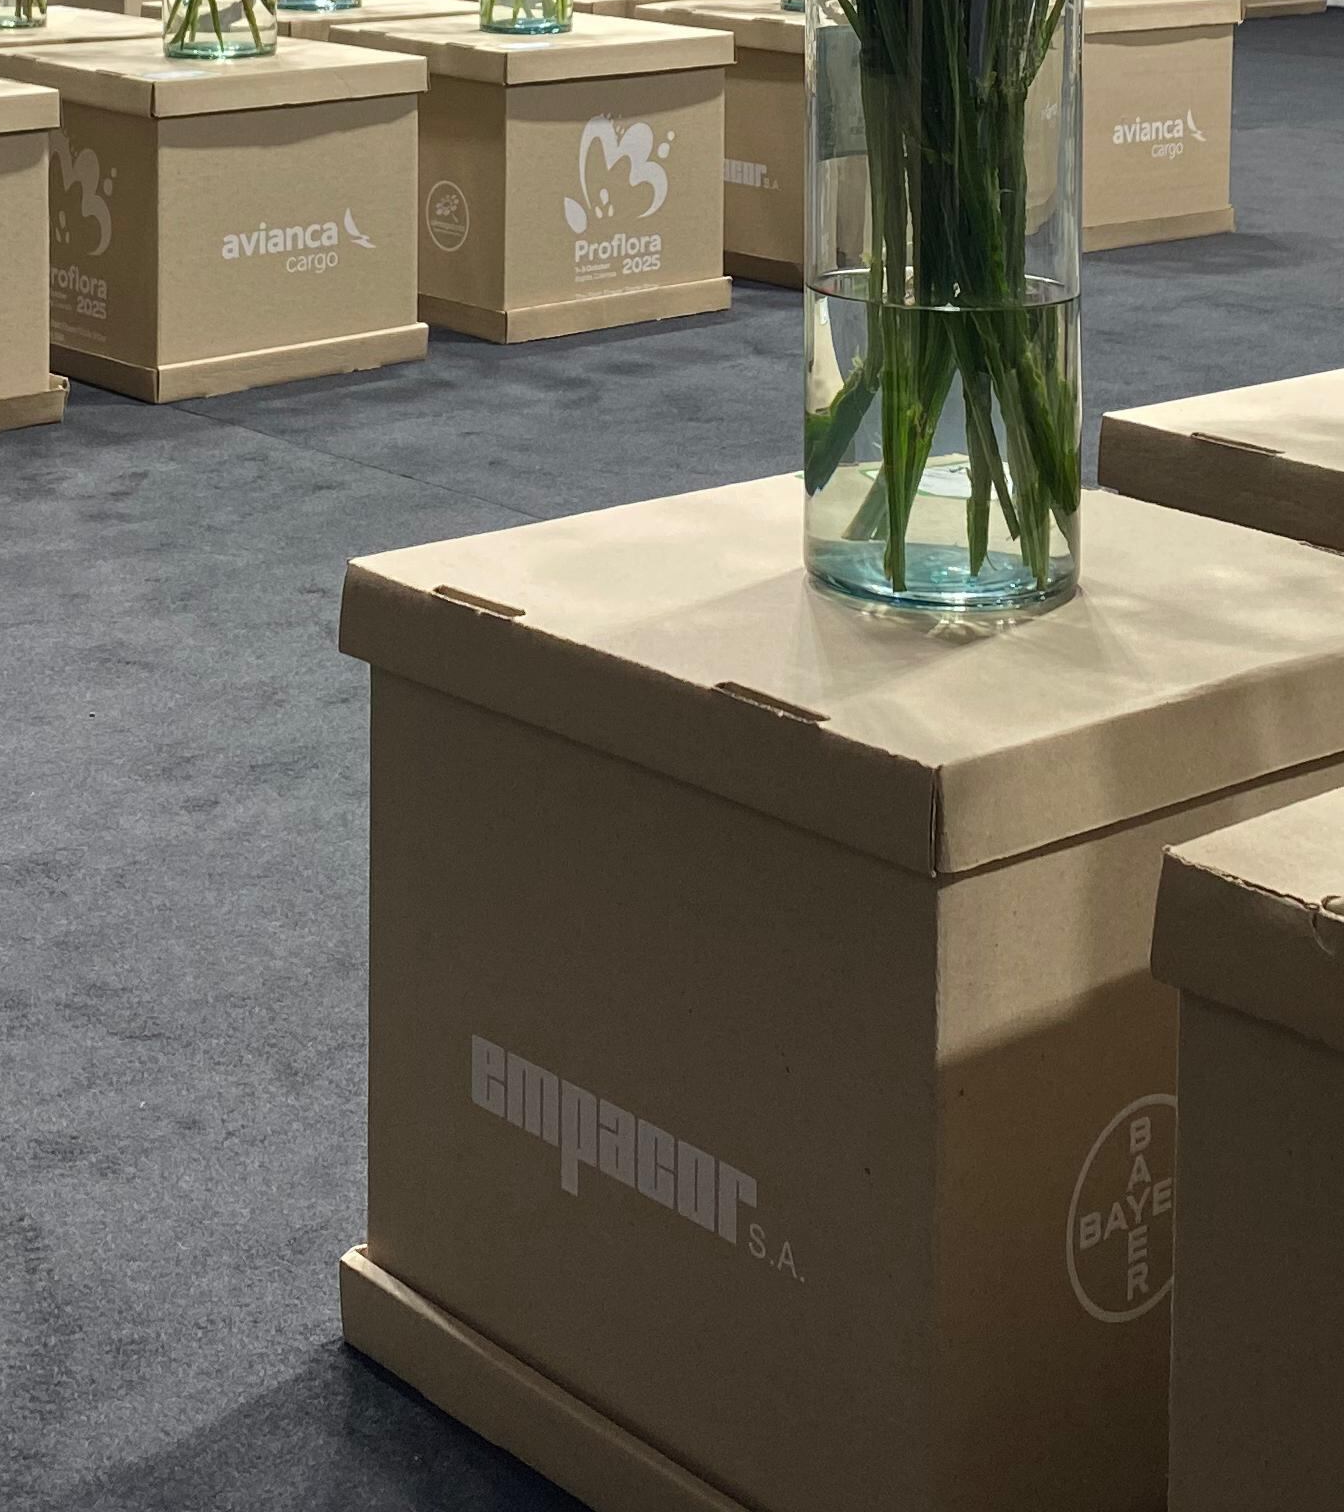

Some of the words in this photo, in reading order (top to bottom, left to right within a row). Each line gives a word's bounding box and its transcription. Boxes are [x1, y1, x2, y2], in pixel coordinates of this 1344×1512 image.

[1112, 116, 1184, 145] avianca
[1151, 142, 1184, 160] cargo
[221, 221, 339, 260] avianca
[575, 233, 662, 263] Proflora
[286, 251, 339, 274] cargo
[622, 254, 661, 275] 2025
[50, 265, 107, 300] roflora
[77, 295, 107, 320] 2025
[472, 1034, 757, 1245] empacor
[748, 1223, 805, 1283] S.A.
[1079, 1176, 1174, 1252] BAYE
[1125, 1115, 1153, 1302] BAYER
